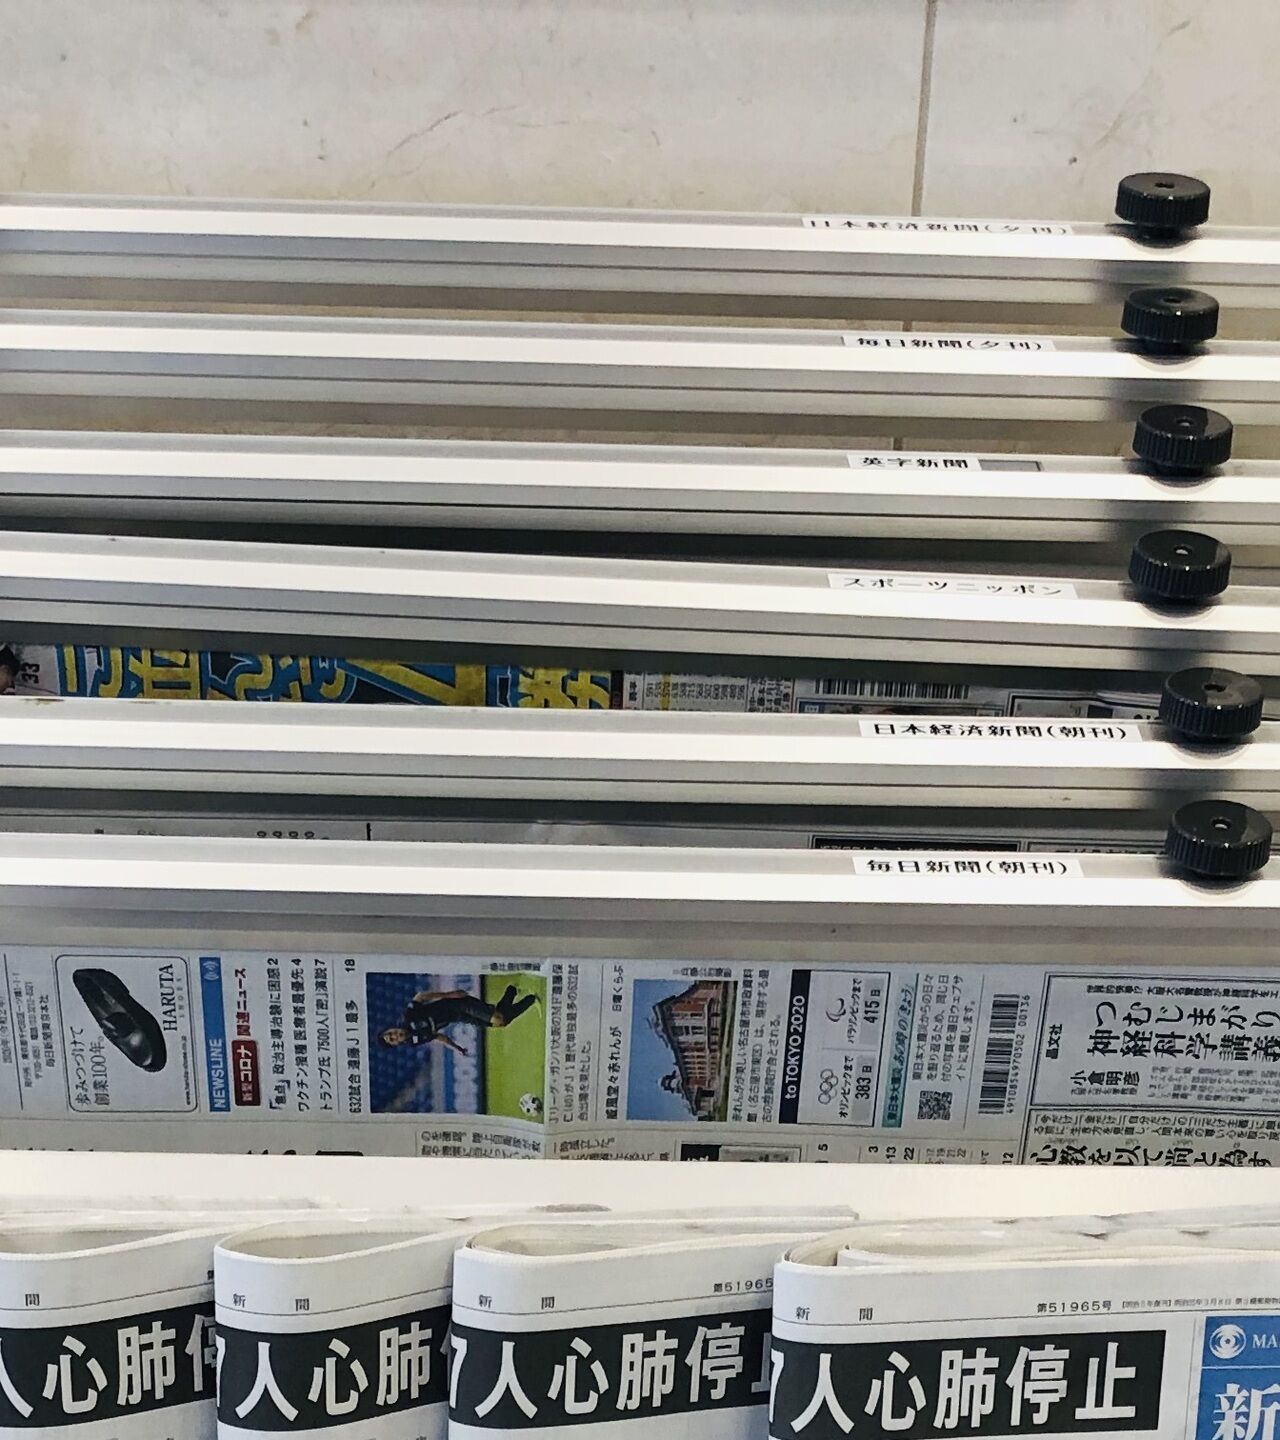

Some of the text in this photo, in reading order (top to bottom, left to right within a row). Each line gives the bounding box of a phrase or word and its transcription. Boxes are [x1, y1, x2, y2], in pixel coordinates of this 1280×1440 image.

[808, 216, 1069, 238] 日本経済新聞(夕刊)
[855, 335, 1044, 353] 毎日新聞(夕刊)
[861, 454, 970, 471] 英字新聞
[843, 576, 1063, 598] スポーツニッポン
[872, 721, 1128, 742] 日本経済新聞(朝刊)
[865, 859, 1069, 878] 毎日新聞(朝刊)
[158, 963, 178, 1032] HARUTA
[784, 994, 805, 1100] to TOKYO 2020
[70, 1025, 92, 1106] 歩みつづけて
[208, 1038, 227, 1112] NEWSLINE
[605, 1025, 623, 1120] 威風堂々赤れんが
[838, 1055, 855, 1119] オリンピックまで
[1036, 1300, 1113, 1314] 第51965号
